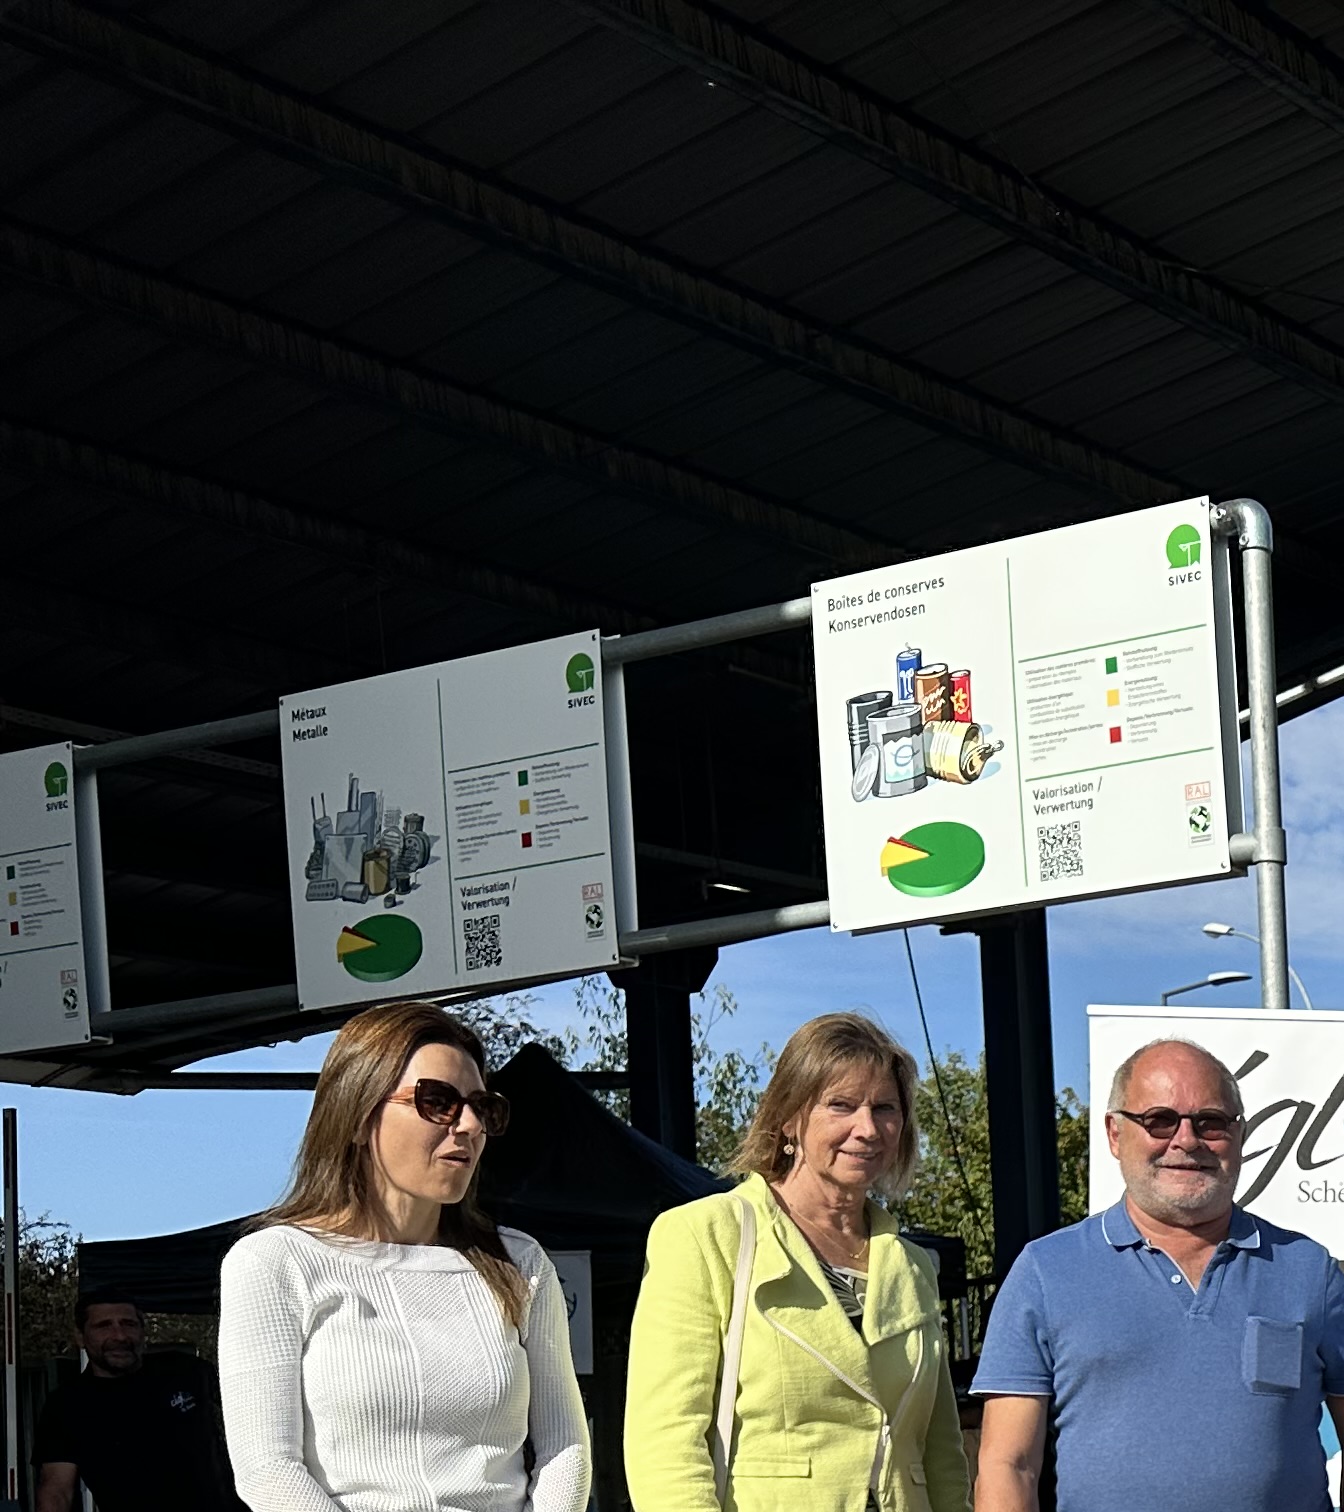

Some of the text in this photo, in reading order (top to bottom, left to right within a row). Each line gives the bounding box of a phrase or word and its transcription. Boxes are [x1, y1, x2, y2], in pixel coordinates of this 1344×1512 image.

[1168, 570, 1202, 586] SIVEC
[867, 589, 881, 603] de
[884, 577, 945, 600] conserves
[828, 603, 926, 634] Konservendosen
[568, 695, 595, 709] SIVEC
[291, 706, 327, 723] Métaux
[292, 724, 328, 742] Metalle
[1032, 775, 1103, 801] Valorisation /
[1186, 784, 1210, 798] RAL
[46, 800, 69, 811] SIVEC
[1033, 797, 1094, 816] Verwertung
[460, 876, 517, 898] Valorisation /
[461, 895, 510, 911] Verwertung
